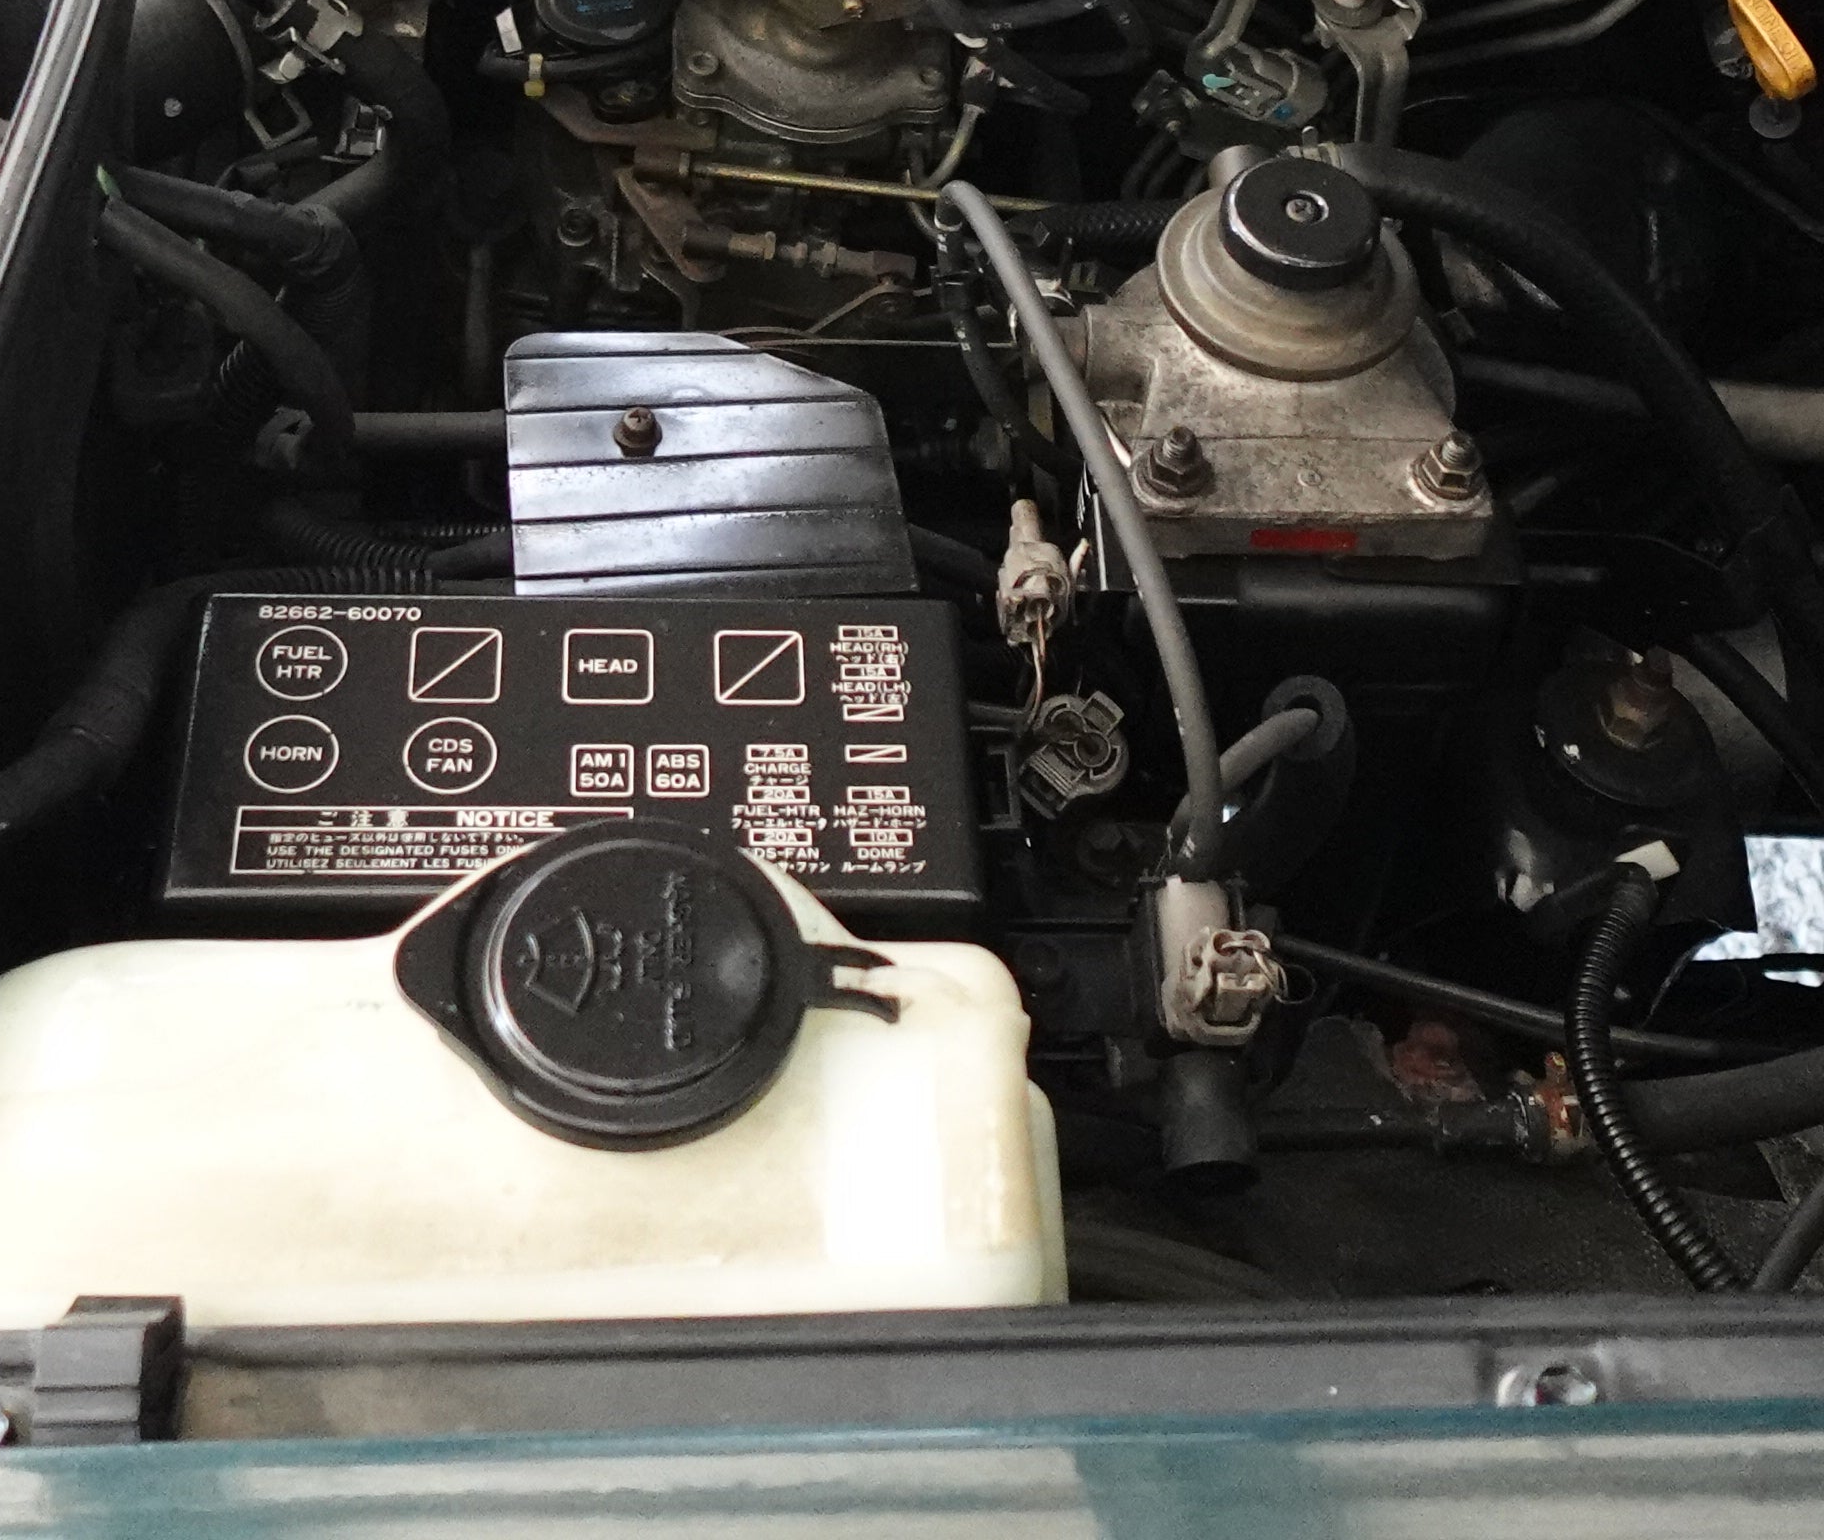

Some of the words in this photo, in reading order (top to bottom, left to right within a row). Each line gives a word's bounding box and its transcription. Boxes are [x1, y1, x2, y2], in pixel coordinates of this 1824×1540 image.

[258, 604, 422, 621] 82662-60070
[272, 645, 332, 660] FUEL
[829, 641, 910, 655] HEAD(RH)
[276, 664, 324, 680] HTR
[578, 658, 639, 674] HEAD
[831, 680, 912, 695] HEAD(LH)
[260, 745, 324, 762] HORN
[428, 738, 474, 754] CDS
[426, 758, 473, 774] FAN
[656, 754, 701, 770] ABS
[744, 763, 812, 775] CHARGE
[579, 773, 625, 788] 50A
[655, 774, 701, 789] 60A
[763, 790, 796, 801] 20A
[867, 789, 895, 800] 15A
[732, 805, 821, 818] FUEL-HTR
[833, 805, 926, 817] HAZ-HORN
[456, 810, 556, 828] NOTICE
[764, 832, 798, 843] 20A
[266, 845, 298, 857] USE
[305, 845, 335, 857] THE
[339, 845, 435, 857] DESIGNATED
[440, 844, 490, 856] FUSES
[752, 847, 820, 860] DS-FAN
[857, 848, 907, 860] DOME
[422, 858, 450, 869] LES
